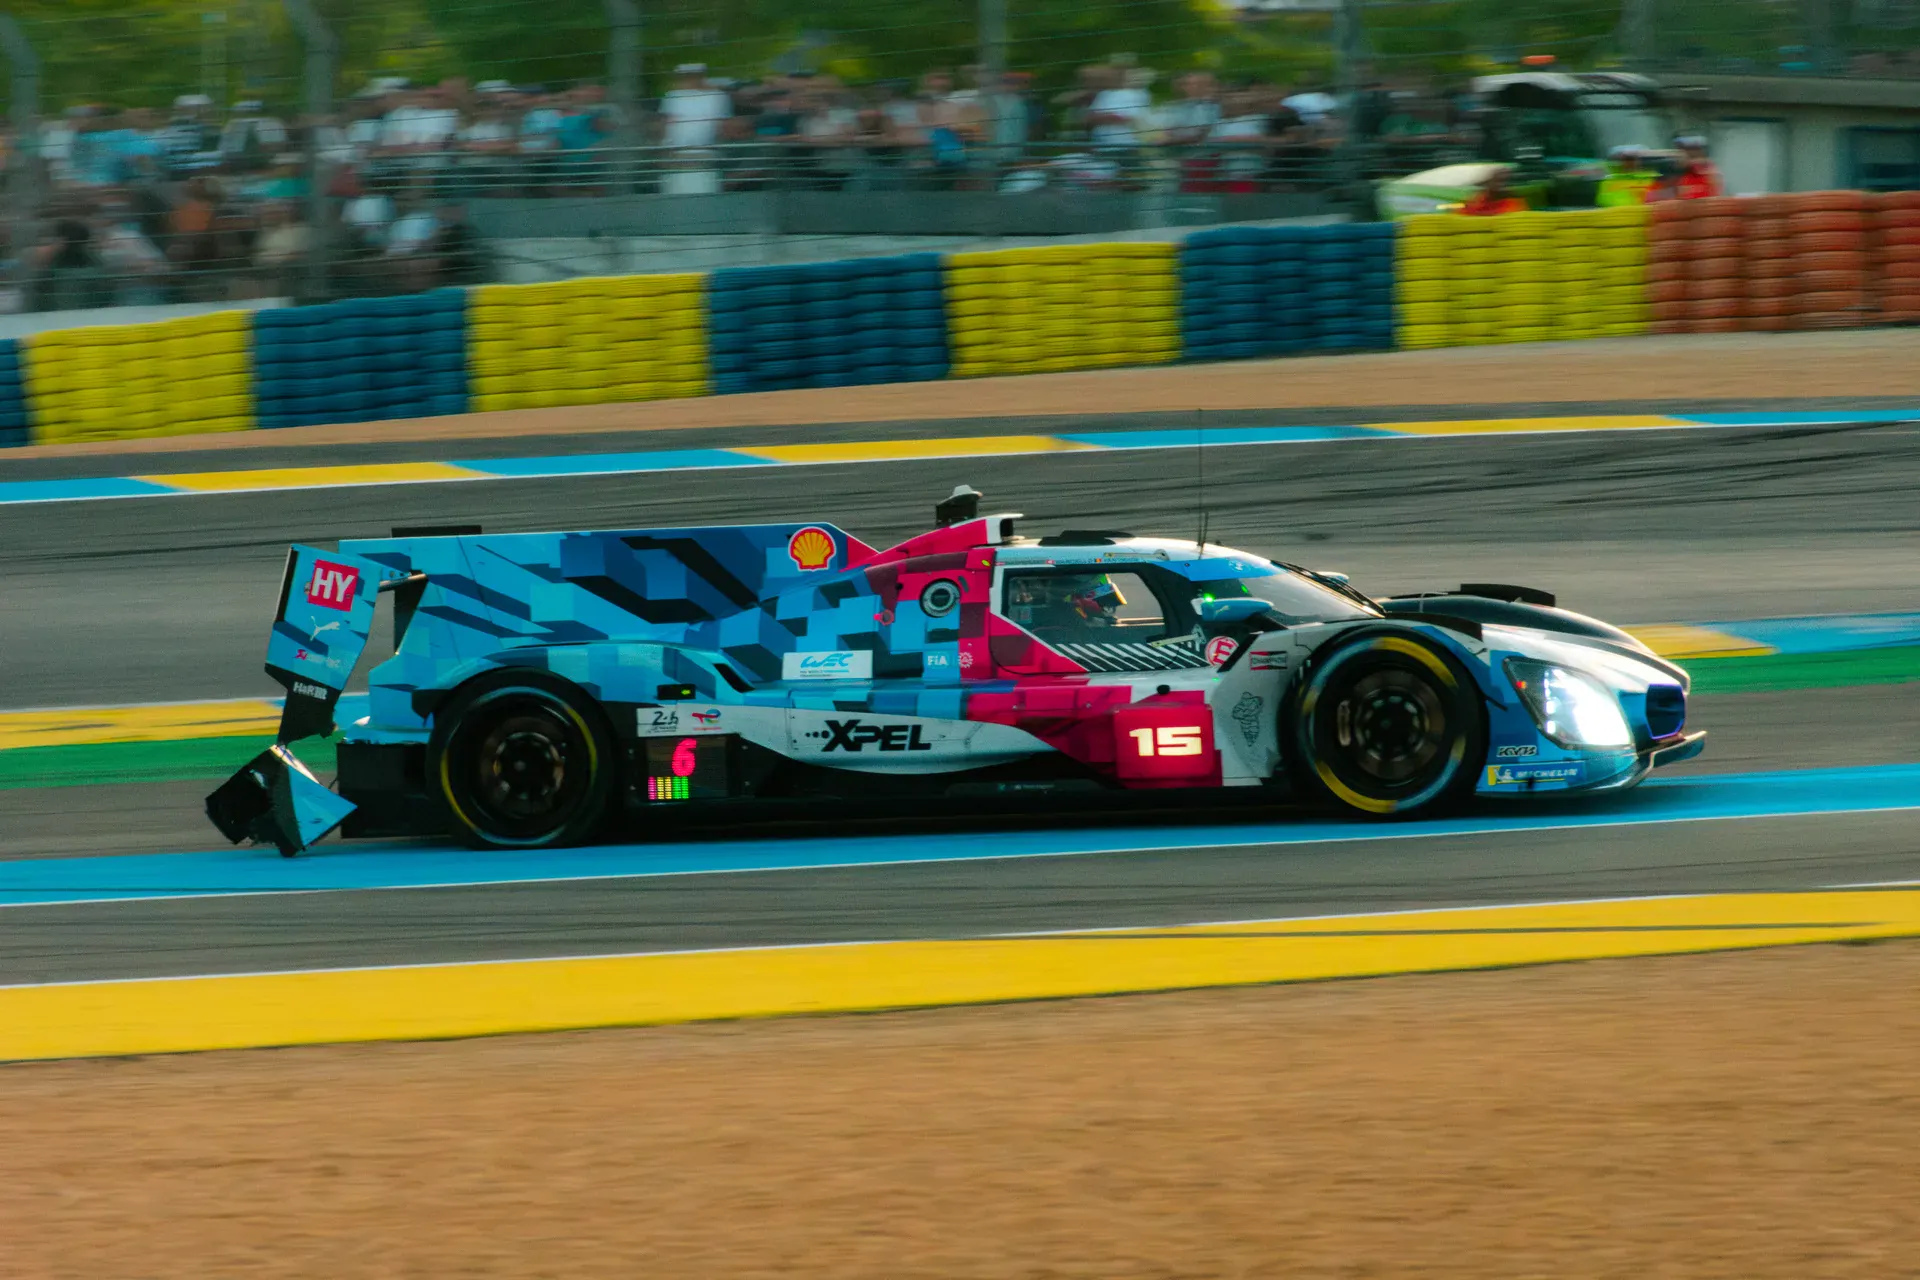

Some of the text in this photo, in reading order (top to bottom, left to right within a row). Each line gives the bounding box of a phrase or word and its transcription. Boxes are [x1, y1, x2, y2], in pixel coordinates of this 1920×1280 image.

[311, 567, 355, 602] HY
[800, 653, 854, 669] WEC
[927, 655, 949, 666] FIA
[821, 719, 932, 752] XPEL
[1129, 726, 1202, 757] 15
[671, 737, 697, 777] 6
[1516, 768, 1578, 779] MICHELIN
